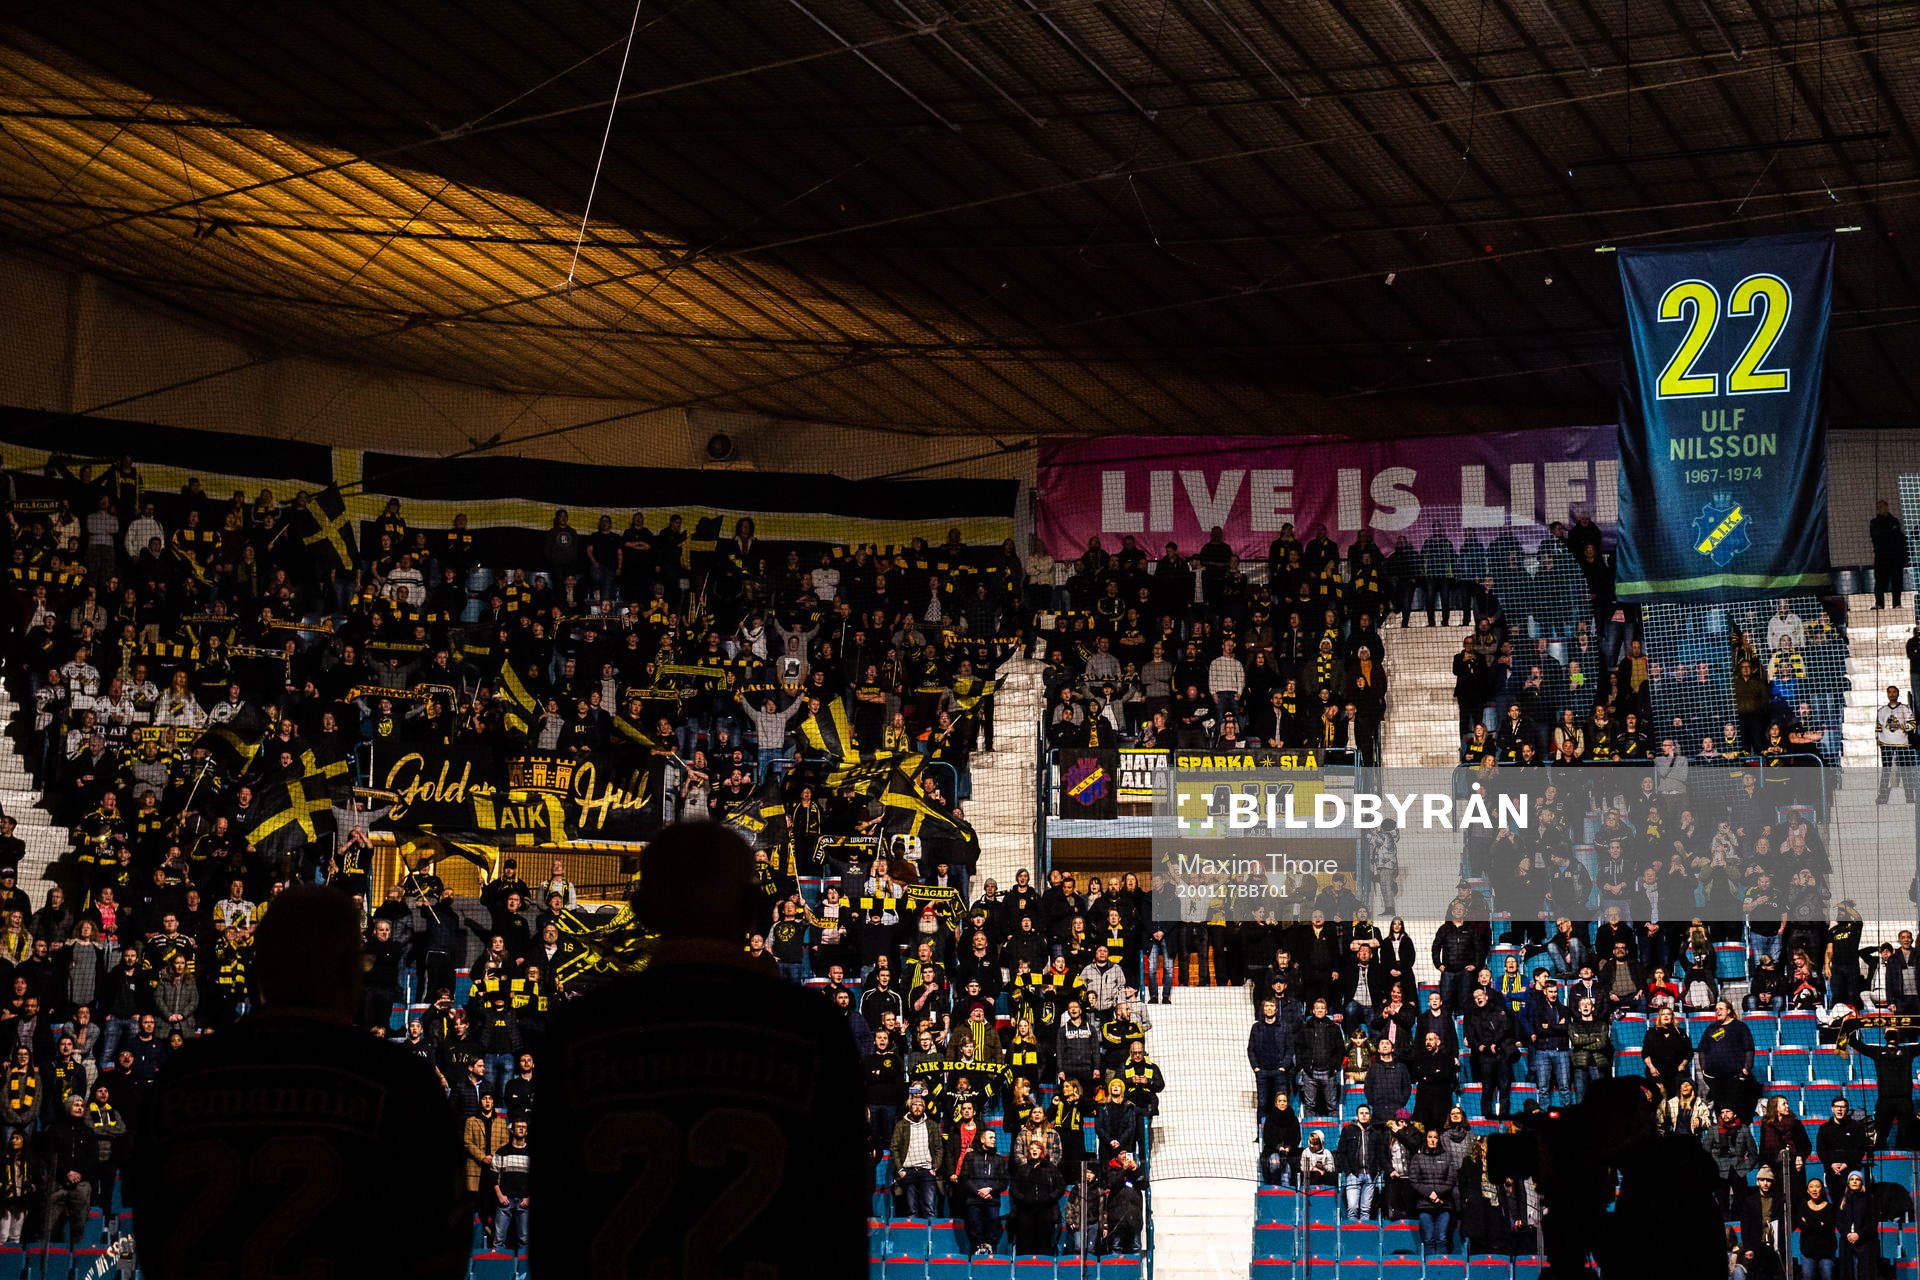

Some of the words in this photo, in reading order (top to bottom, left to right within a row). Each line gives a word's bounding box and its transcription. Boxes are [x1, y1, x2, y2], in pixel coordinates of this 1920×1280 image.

[1656, 272, 1793, 400] 22
[1701, 407, 1745, 433] ULF
[1669, 433, 1777, 462] NILSSON
[1685, 467, 1762, 484] 1967-1974
[1101, 468, 1295, 532] LIVE
[1337, 466, 1421, 531] IS
[1120, 754, 1168, 771] HATA
[1177, 755, 1256, 772] SPARKA
[1279, 750, 1319, 772] SLÅ
[1121, 771, 1168, 788] ALLA
[573, 761, 653, 830] Hill
[1208, 783, 1295, 817] AIK
[500, 803, 547, 830] AIK
[915, 1060, 940, 1074] AIK
[942, 1061, 1007, 1074] HOCKEY
